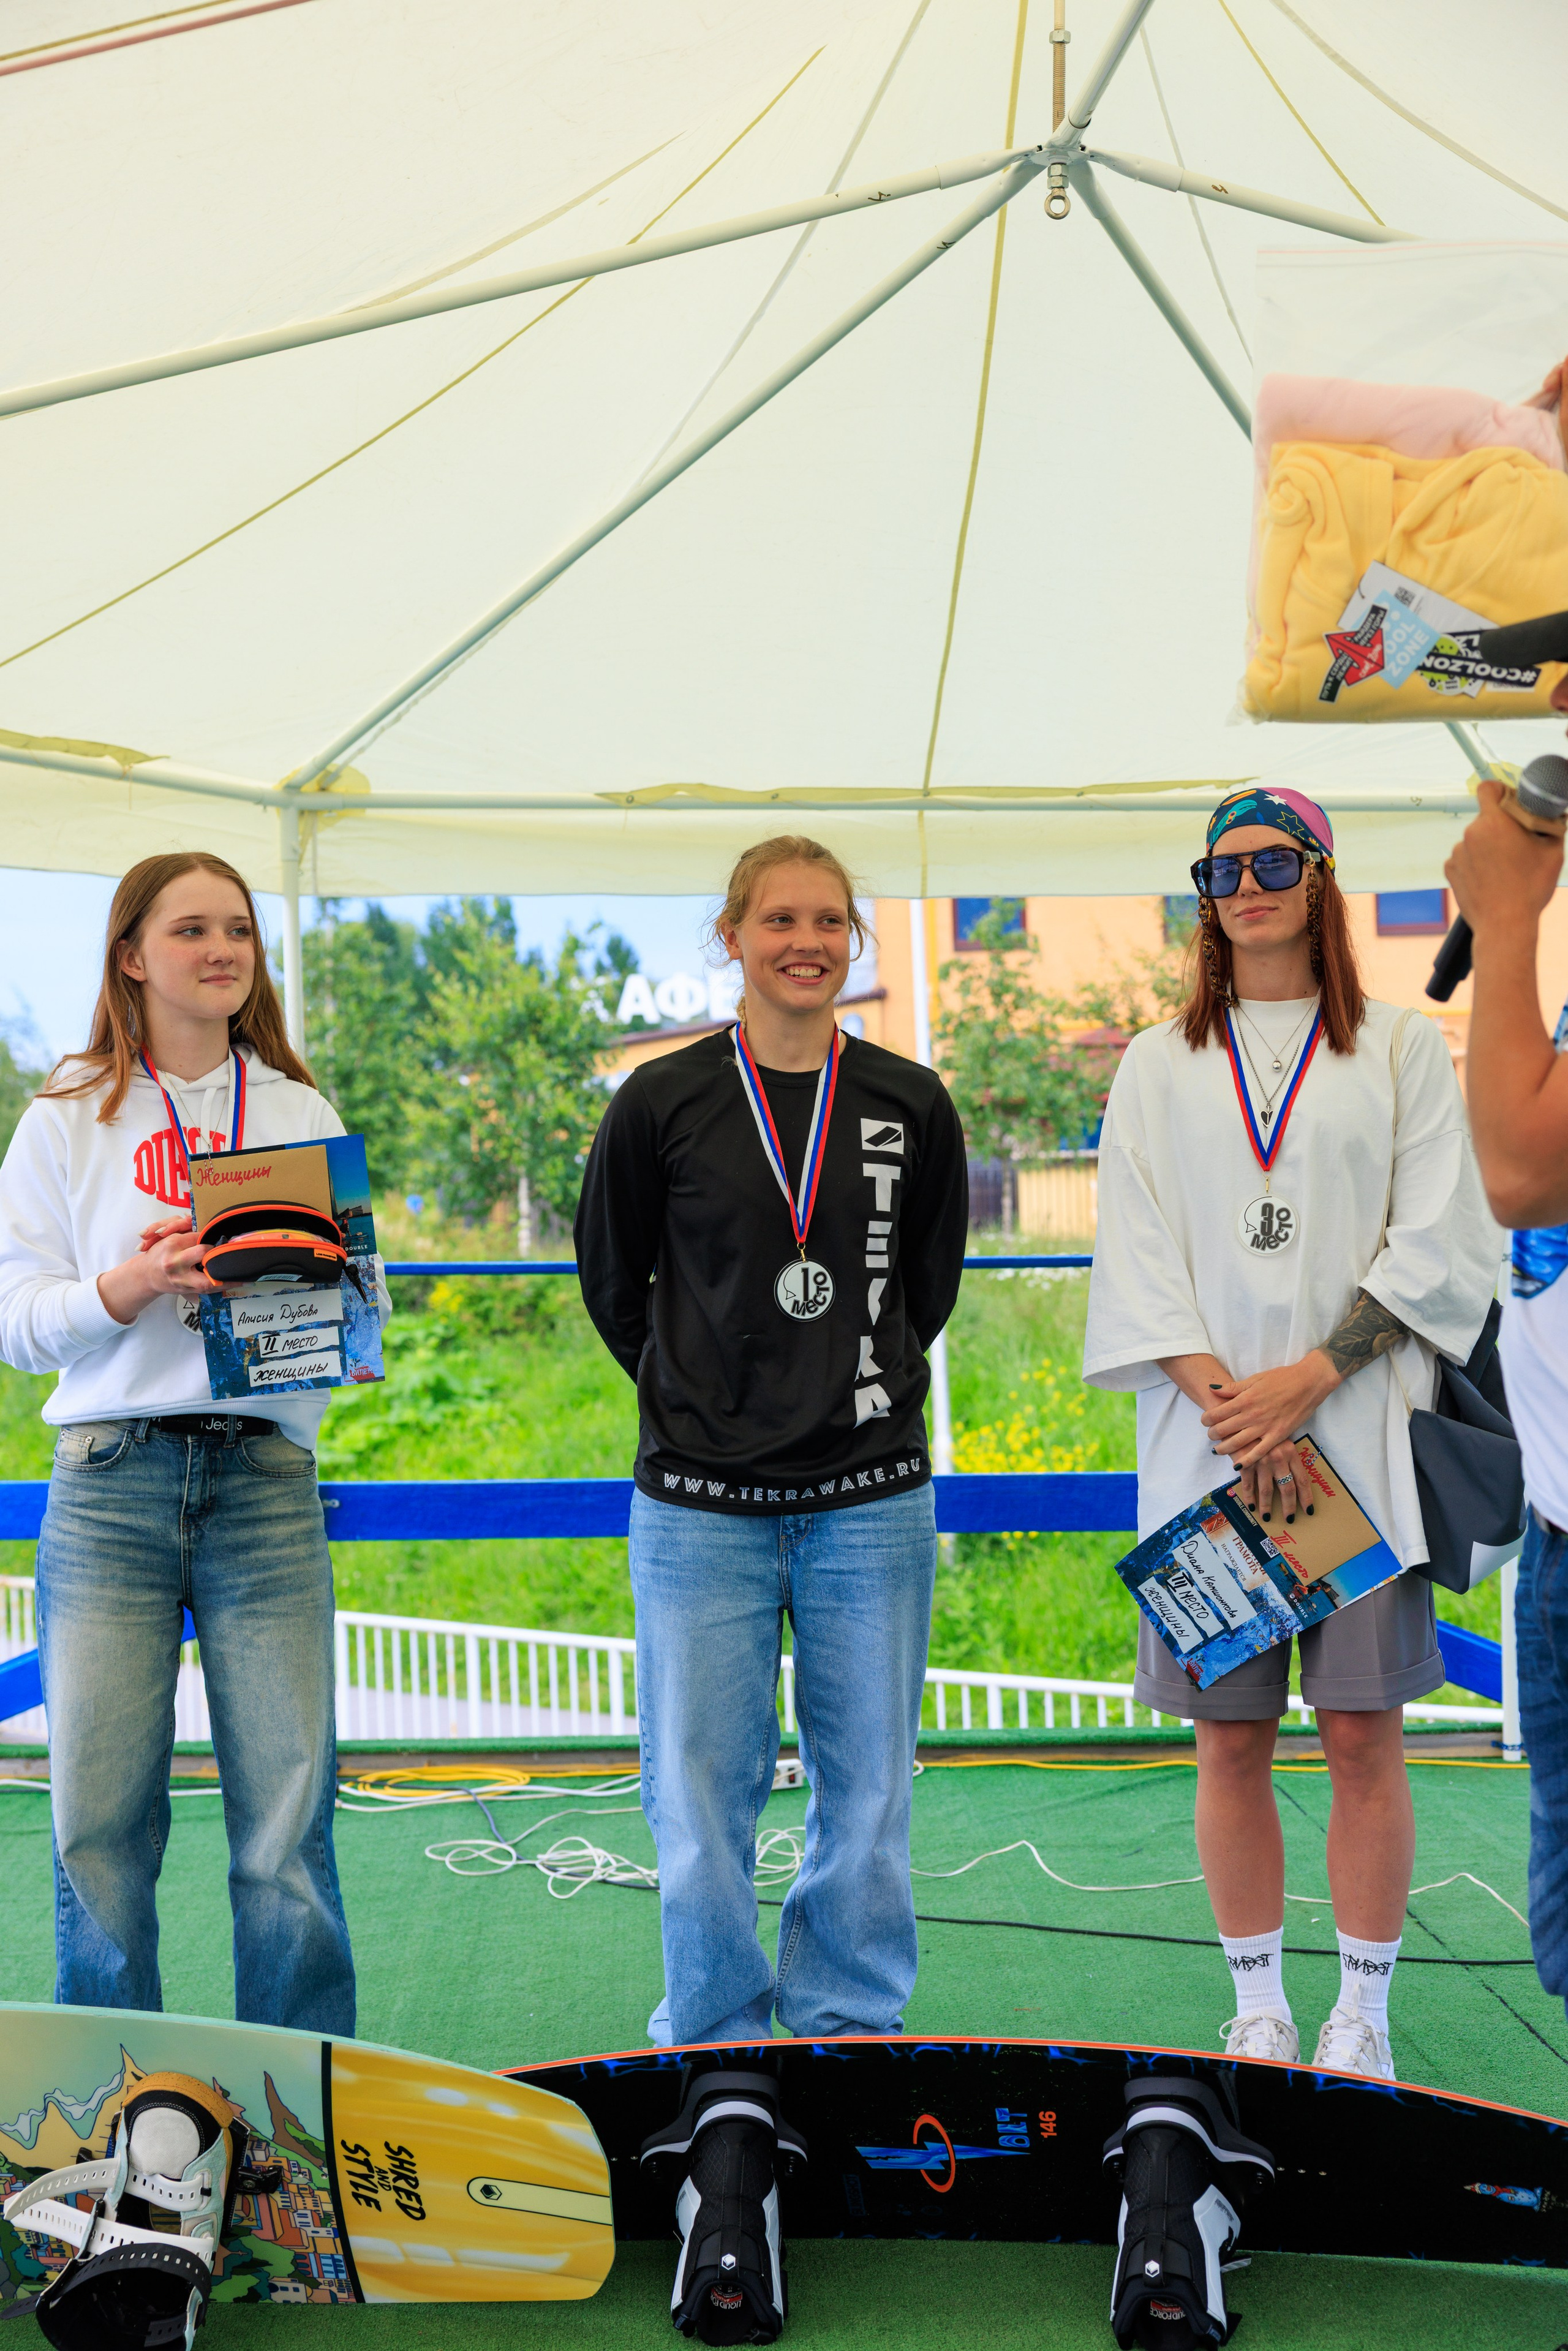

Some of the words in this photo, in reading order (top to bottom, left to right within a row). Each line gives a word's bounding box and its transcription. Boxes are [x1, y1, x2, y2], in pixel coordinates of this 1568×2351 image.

[1384, 621, 1416, 652] OOL
[1386, 628, 1430, 677] ZONE
[1261, 1202, 1275, 1236] 3
[801, 1267, 809, 1302] 1
[238, 1311, 274, 1326] Алисия
[280, 1304, 318, 1323] Дубова
[664, 1458, 920, 1501] WWW.TEKRAWAKE.RU
[1233, 1496, 1257, 1526] DOUBLE.COMMUNITY
[1180, 1541, 1204, 1574] Диана
[1221, 1543, 1246, 1582] НАГРАЖДАЕТСЯ
[1232, 1536, 1258, 1574] ГРАМОТА
[1293, 1598, 1308, 1618] DOUBLE
[1039, 2111, 1057, 2138] 146
[341, 2140, 382, 2213] STYLE
[374, 2165, 392, 2191] AND
[384, 2141, 426, 2221] SHRED
[719, 2300, 741, 2309] LIQUID
[1149, 2307, 1172, 2320] FORCE
